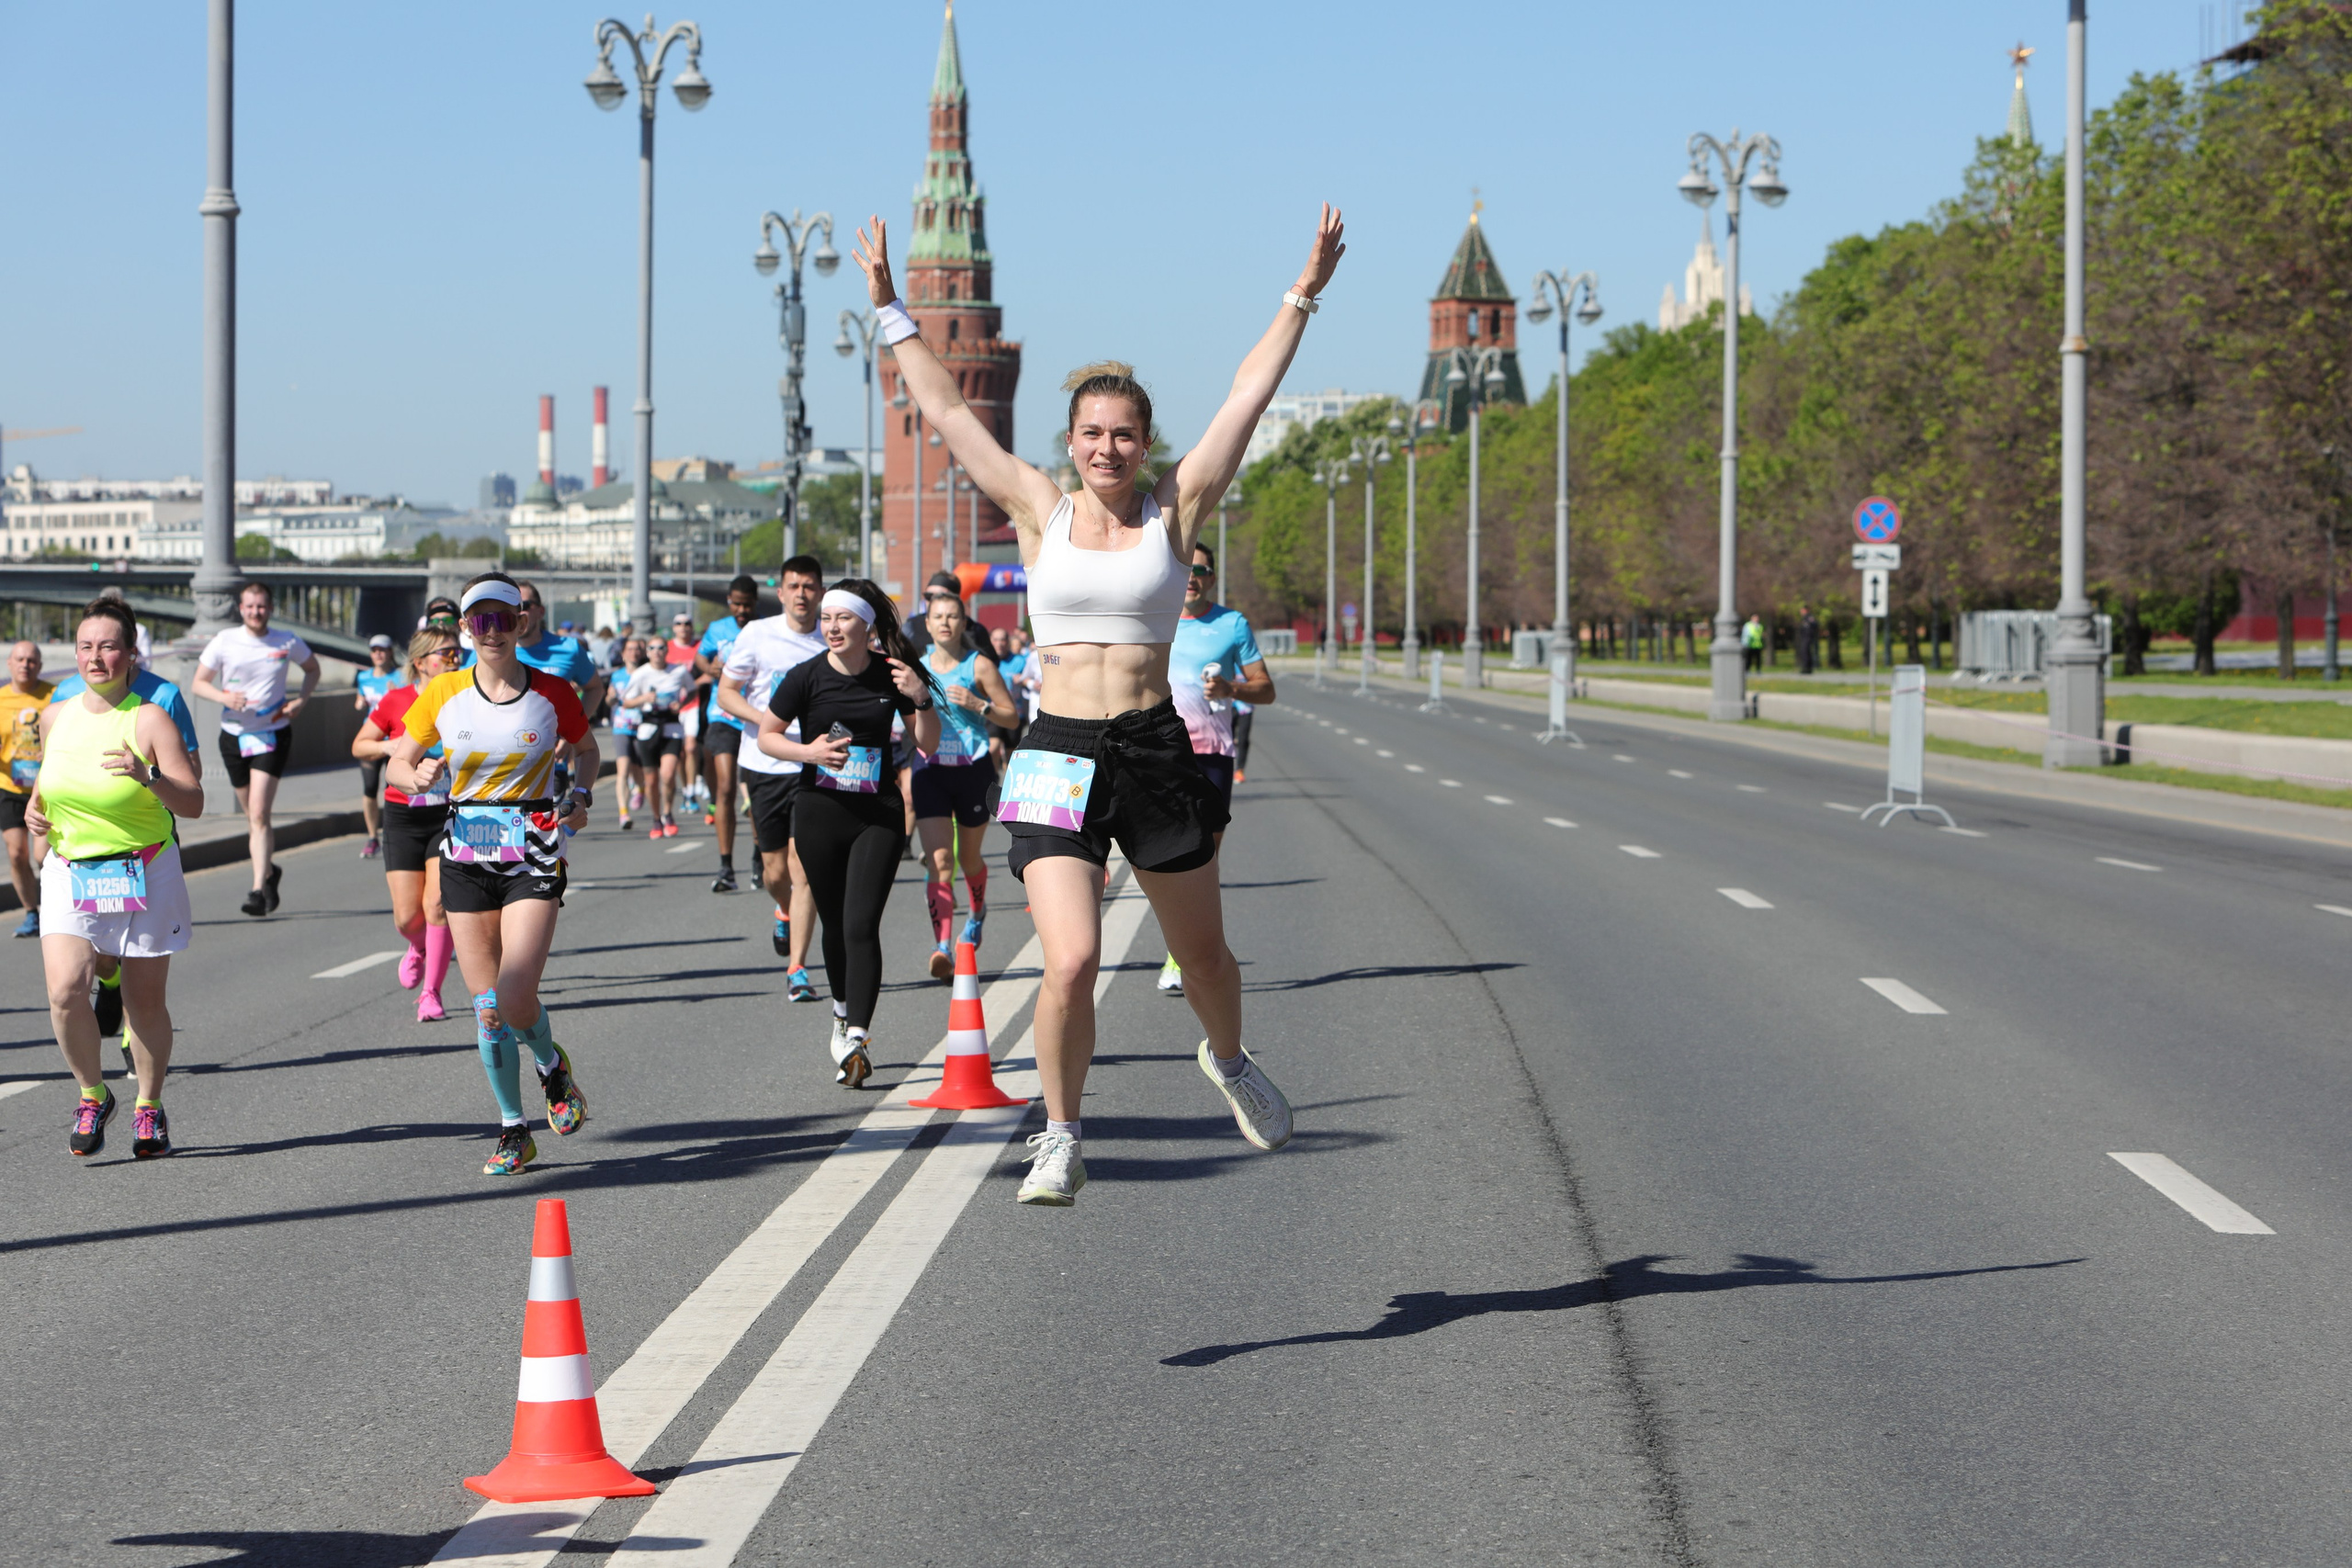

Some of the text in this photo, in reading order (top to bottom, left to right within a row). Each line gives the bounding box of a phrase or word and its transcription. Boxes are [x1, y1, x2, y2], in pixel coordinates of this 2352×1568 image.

[936, 740, 963, 753] 3251
[830, 760, 870, 778] 346
[835, 777, 861, 793] 10KM
[1012, 773, 1070, 804] 34673
[1071, 785, 1081, 796] B
[1016, 801, 1053, 825] 10KM
[513, 818, 521, 826] C
[466, 823, 509, 844] 30145
[473, 846, 501, 862] 10KM
[86, 876, 130, 897] 31256
[95, 897, 125, 913] 10KM
